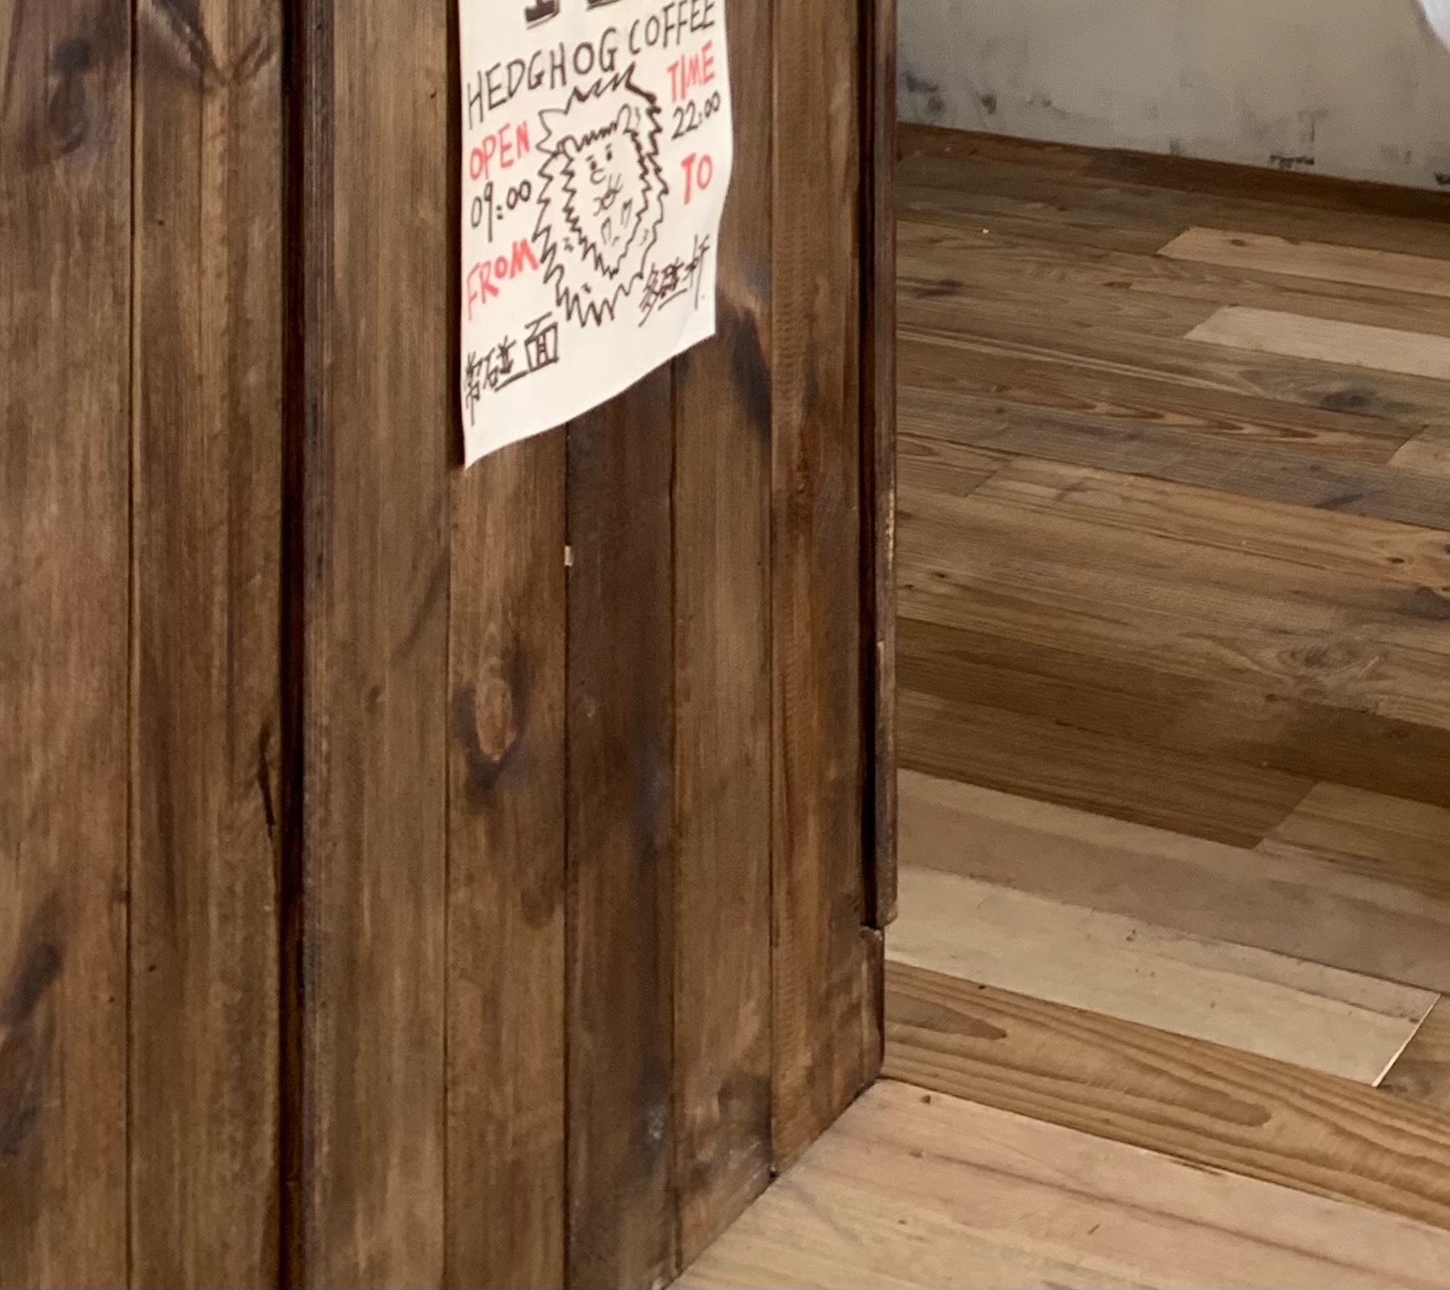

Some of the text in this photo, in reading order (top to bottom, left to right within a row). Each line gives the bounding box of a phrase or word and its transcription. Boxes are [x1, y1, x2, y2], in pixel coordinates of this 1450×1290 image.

[468, 27, 617, 130] HEDGHOG
[469, 41, 716, 181] OPEN TIME
[466, 151, 713, 321] FROM TO
[470, 91, 722, 242] 09:00 22:00
